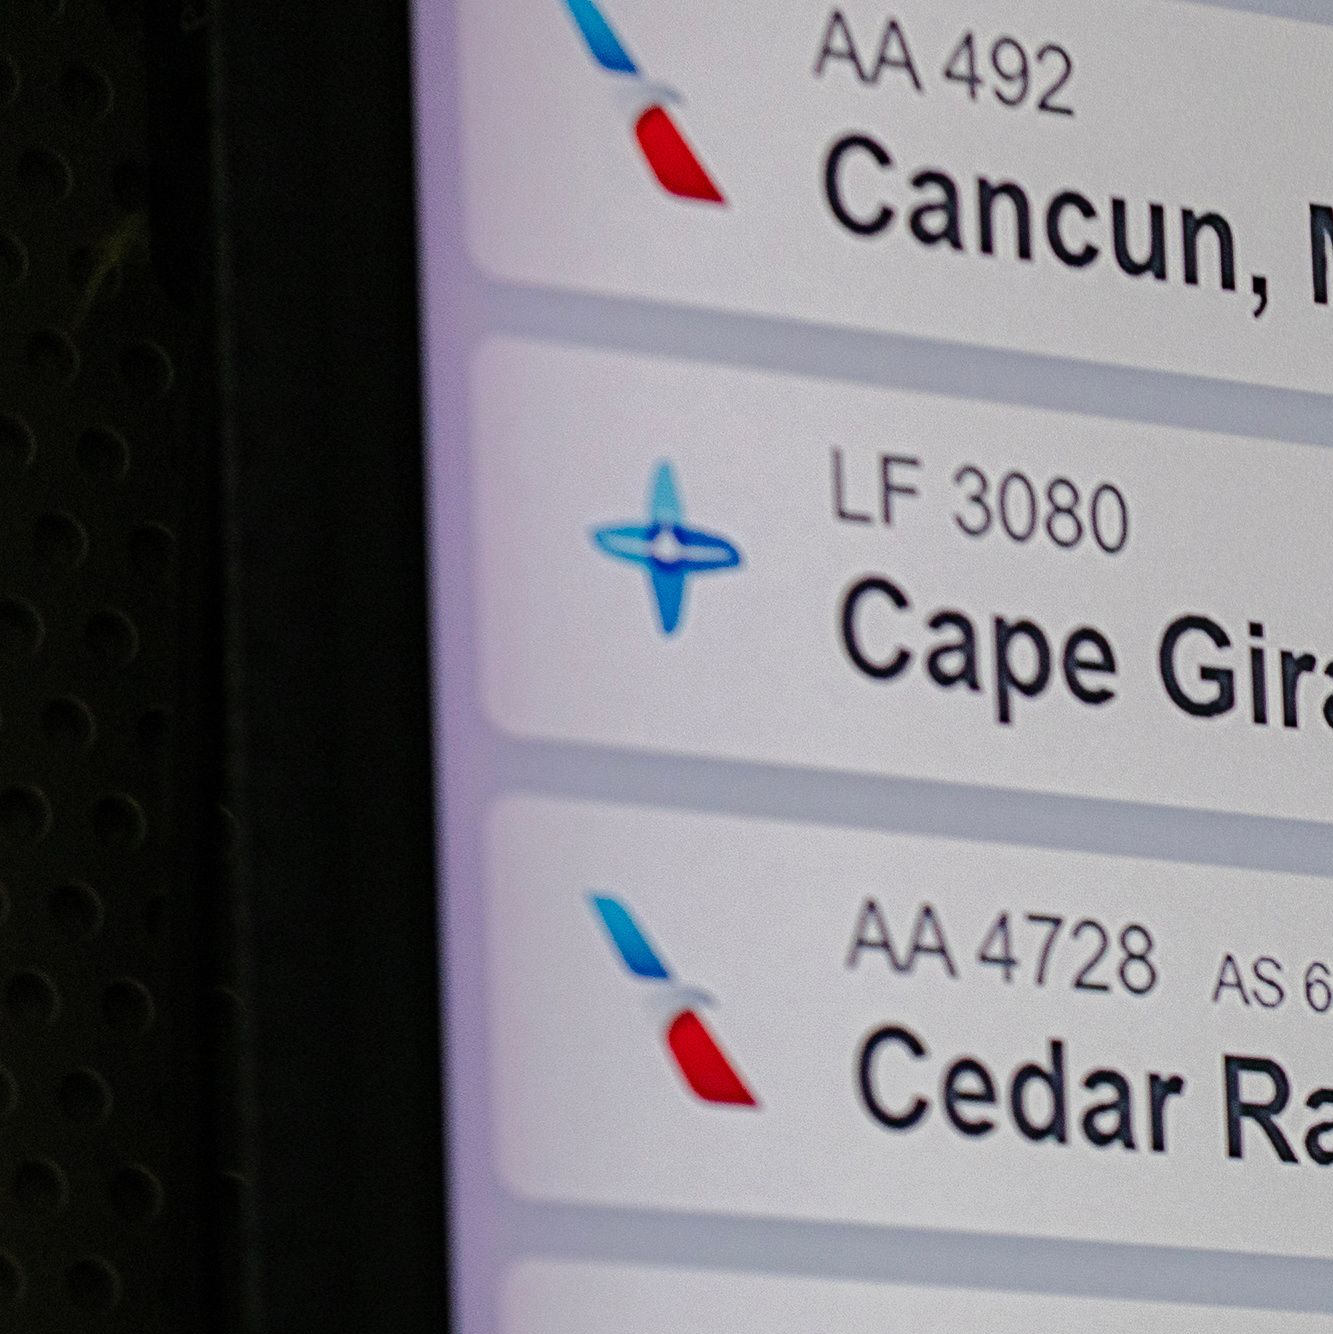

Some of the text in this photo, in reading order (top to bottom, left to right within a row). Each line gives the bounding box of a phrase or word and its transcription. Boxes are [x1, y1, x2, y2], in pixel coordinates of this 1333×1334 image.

[813, 7, 1075, 118] AA 492
[823, 133, 1269, 318] Cancun,
[831, 449, 1131, 557] LF 3080
[839, 575, 1118, 726] Cape
[847, 898, 958, 978] AA
[976, 912, 1159, 998] 4728
[1211, 952, 1287, 1010] AS
[856, 1024, 1185, 1154] Cedar
